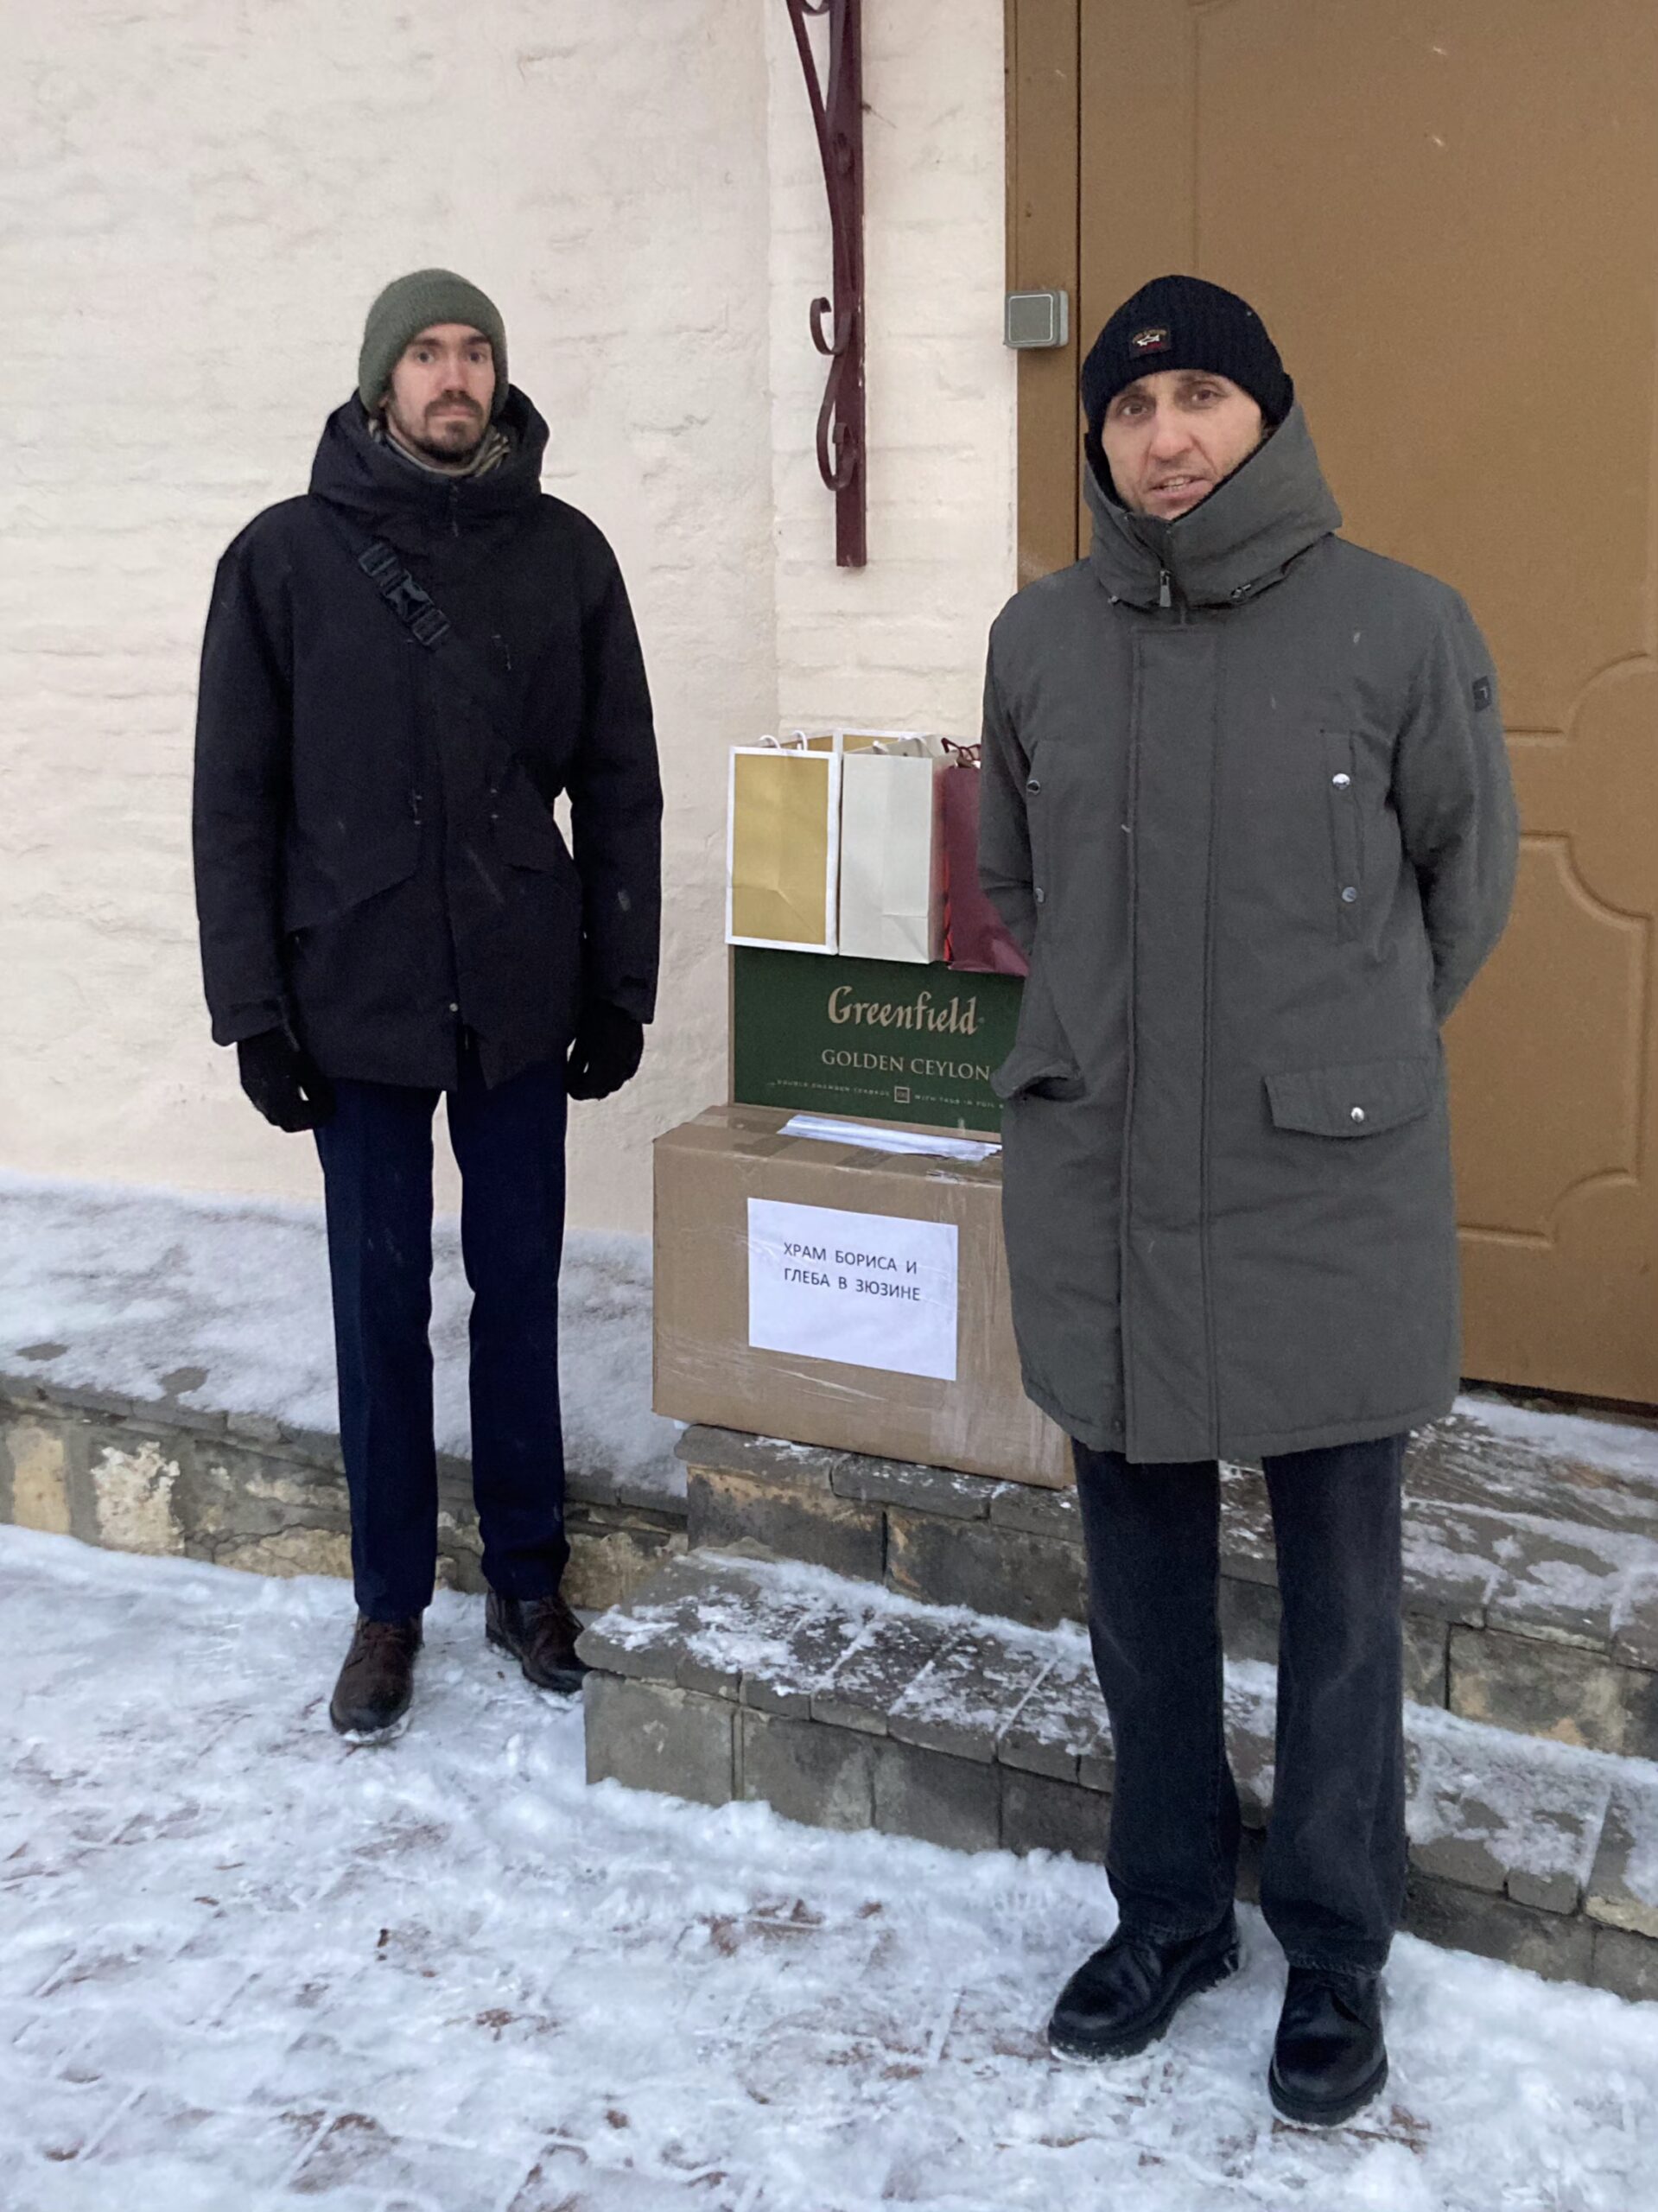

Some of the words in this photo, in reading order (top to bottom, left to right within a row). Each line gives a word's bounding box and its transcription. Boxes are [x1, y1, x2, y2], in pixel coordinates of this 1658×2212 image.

[828, 985, 978, 1035] Greenfield
[822, 1049, 904, 1071] GOLDEN
[911, 1058, 990, 1081] CEYLON
[784, 1242, 826, 1261] ХРАМ
[835, 1250, 897, 1272] БОРИСА
[906, 1261, 918, 1274] И
[784, 1268, 830, 1287] ГЛЕБА
[838, 1276, 848, 1290] В
[855, 1280, 921, 1301] ЗЮЗИНЕ
